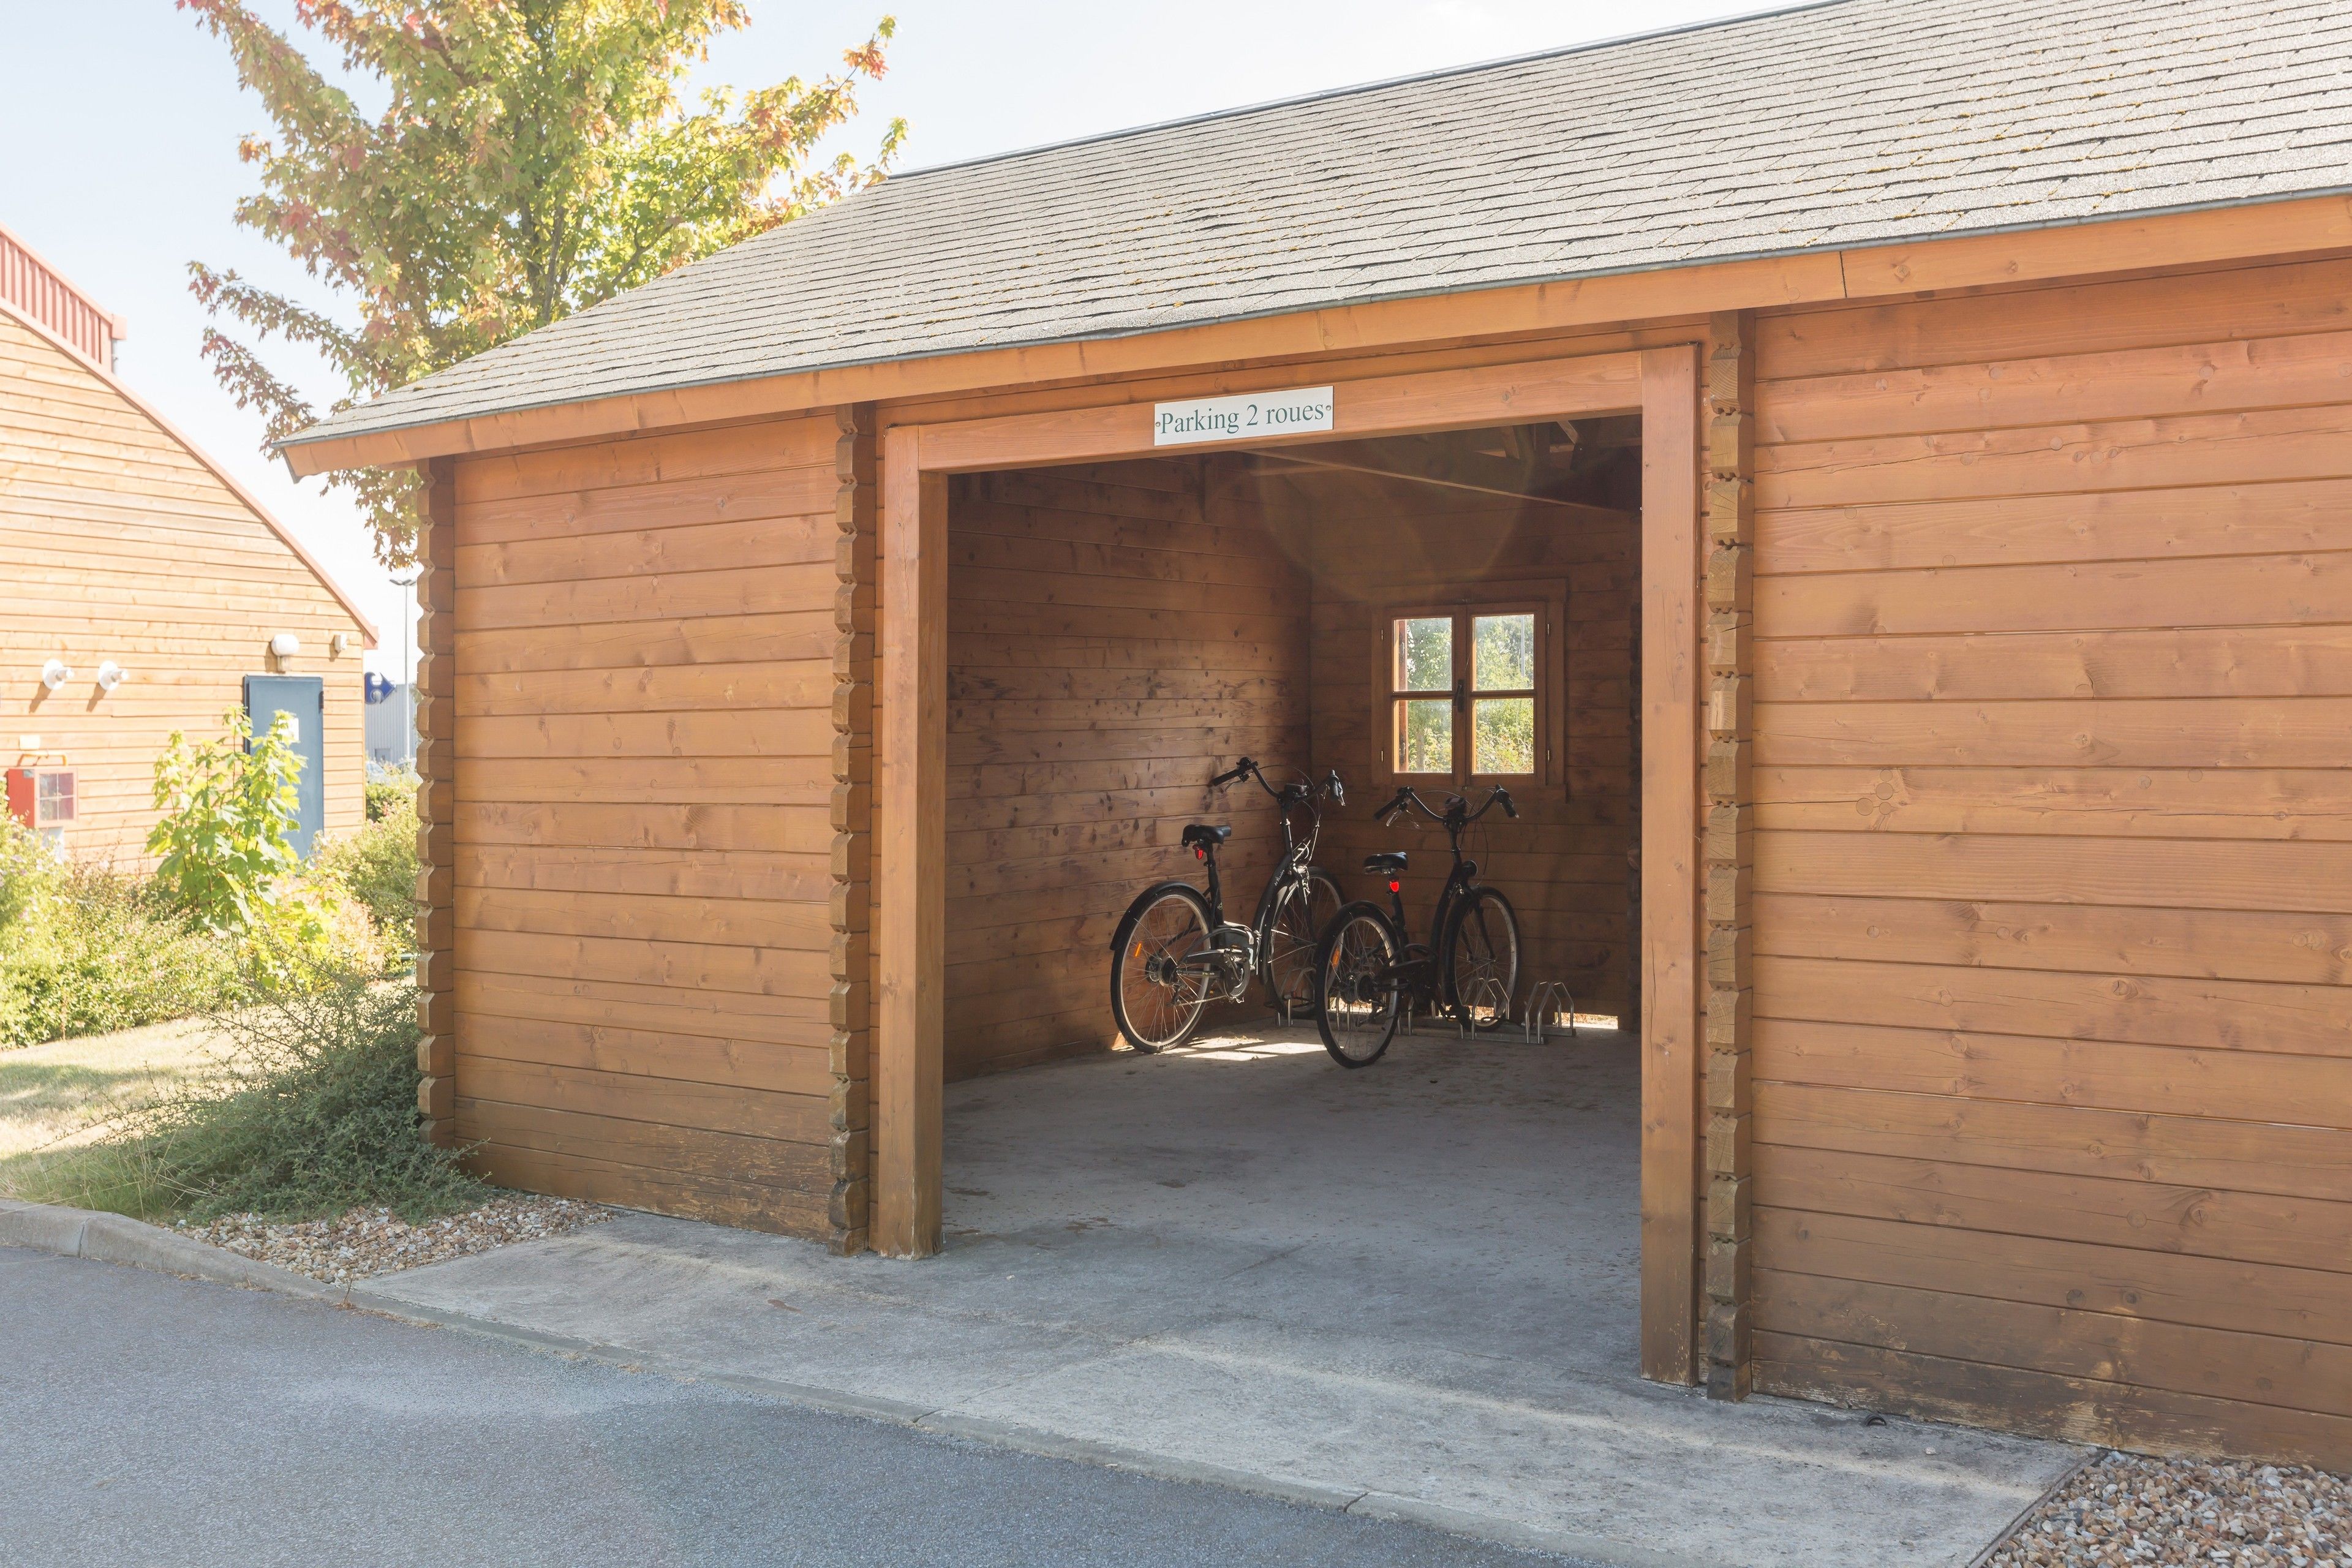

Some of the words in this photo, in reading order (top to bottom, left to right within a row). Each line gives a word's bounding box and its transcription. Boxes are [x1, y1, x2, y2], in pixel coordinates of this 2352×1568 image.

[1161, 408, 1240, 434] Parking
[1246, 404, 1259, 426] 2
[1266, 404, 1324, 424] roues
